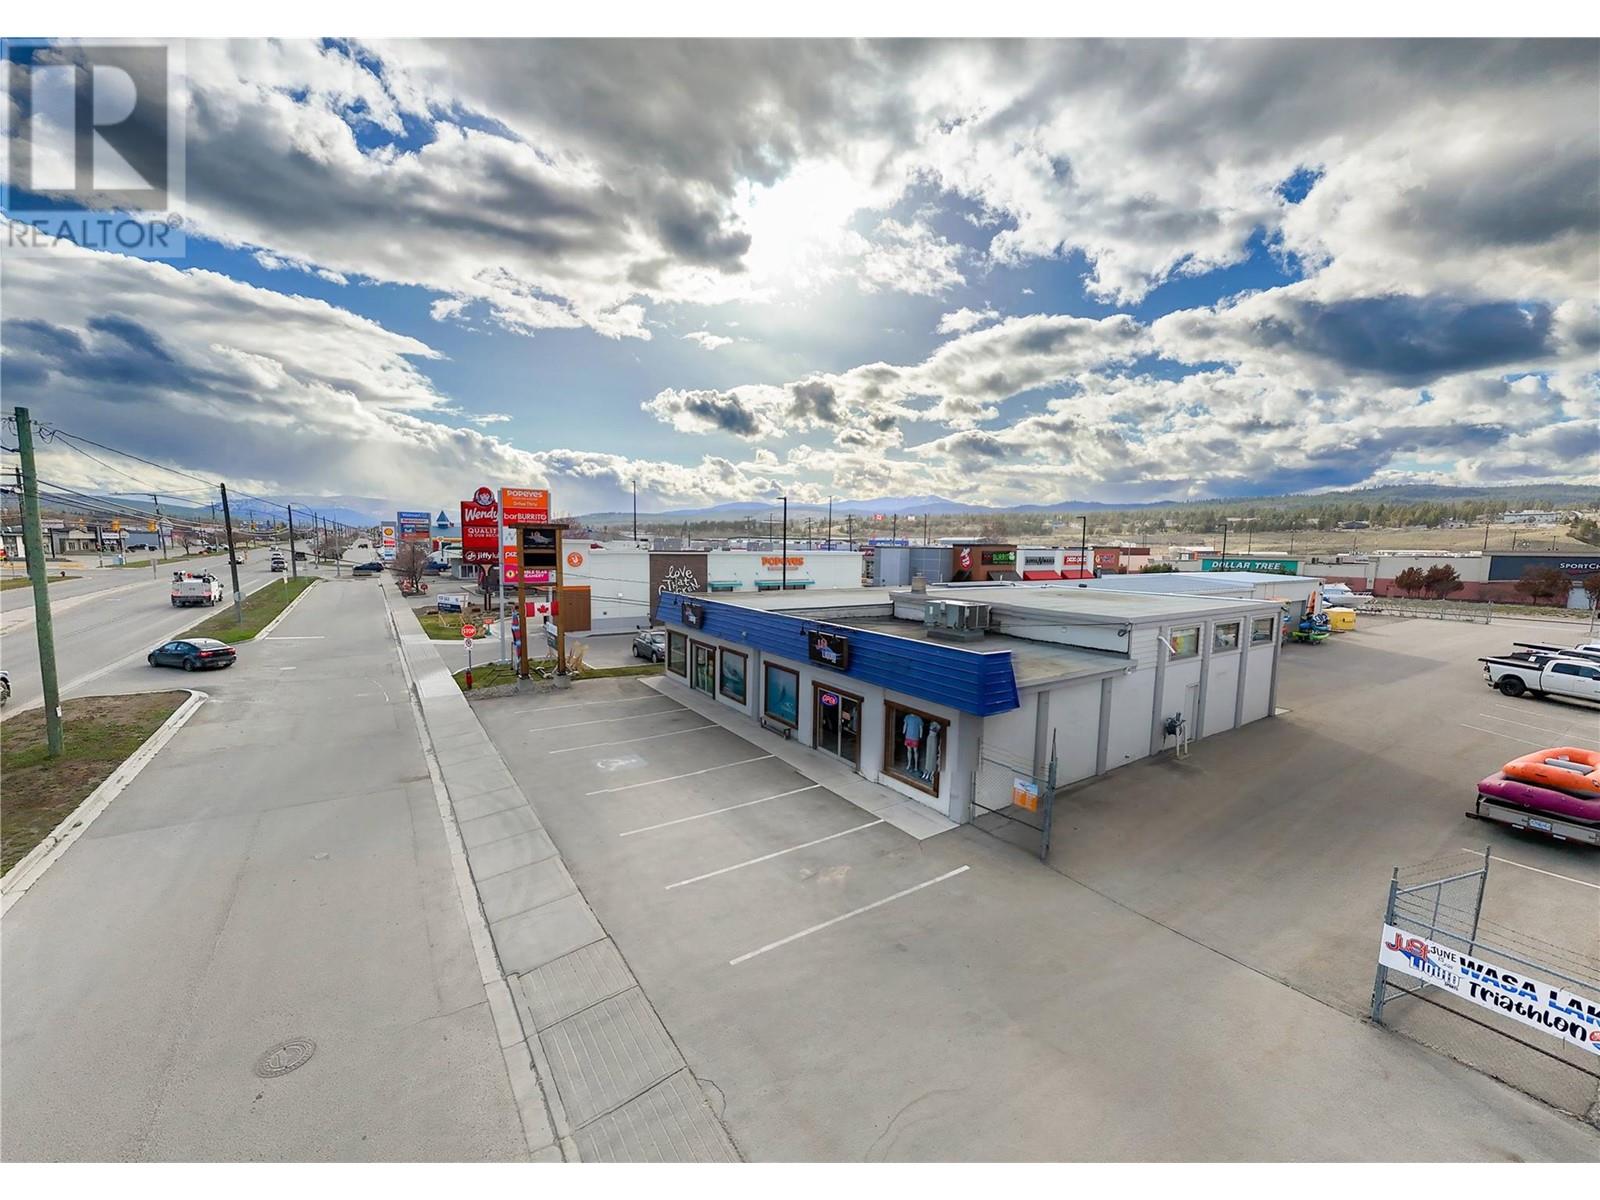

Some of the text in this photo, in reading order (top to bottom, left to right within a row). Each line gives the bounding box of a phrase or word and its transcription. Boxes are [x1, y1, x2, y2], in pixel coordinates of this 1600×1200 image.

[506, 490, 544, 498] POPEYES
[503, 512, 547, 520] barBURRITO
[1212, 560, 1281, 570] DOLLAR TREE
[462, 627, 476, 635] STOP
[822, 693, 836, 706] OPEN
[1430, 945, 1457, 963] JUNE
[1460, 957, 1539, 1002] WASA
[1468, 981, 1587, 1043] Triathlon
